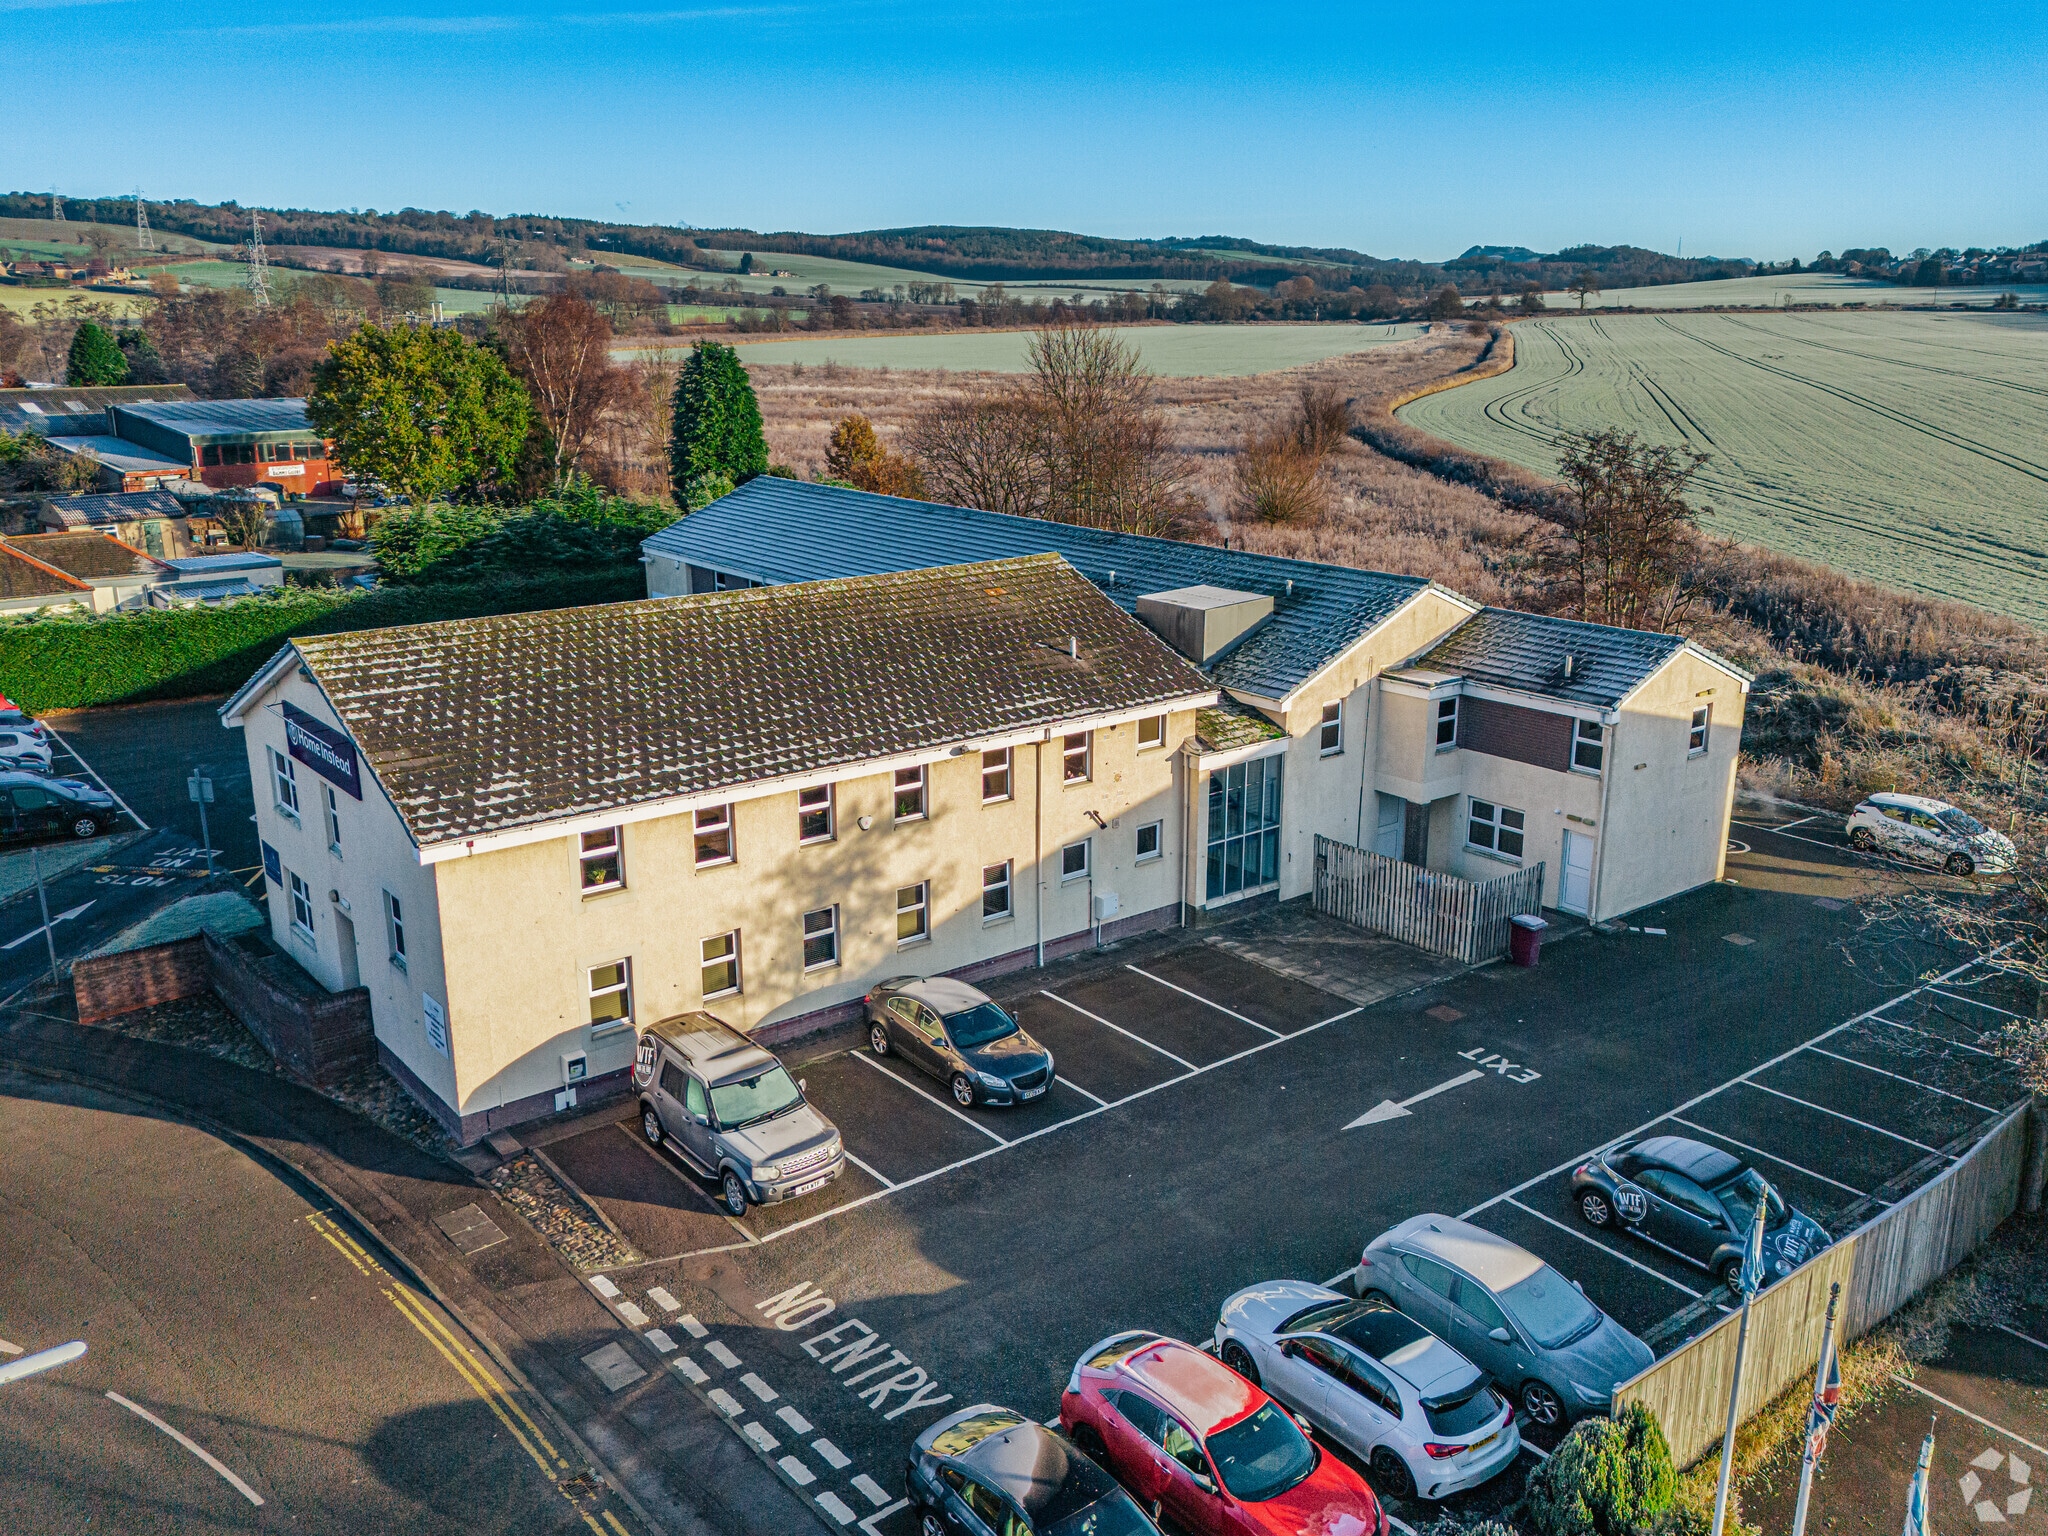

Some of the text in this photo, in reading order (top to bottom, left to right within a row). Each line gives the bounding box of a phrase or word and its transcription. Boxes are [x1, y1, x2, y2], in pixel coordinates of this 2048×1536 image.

[297, 727, 352, 776] Home Instead
[148, 857, 192, 868] NO
[154, 847, 225, 858] EXIT
[95, 874, 177, 888] SLOW
[636, 1045, 655, 1065] WTF
[1457, 1047, 1542, 1084] EXIT
[1618, 1192, 1641, 1207] WTF
[1783, 1236, 1800, 1258] WTF
[755, 1280, 954, 1421] NO ENTRY
